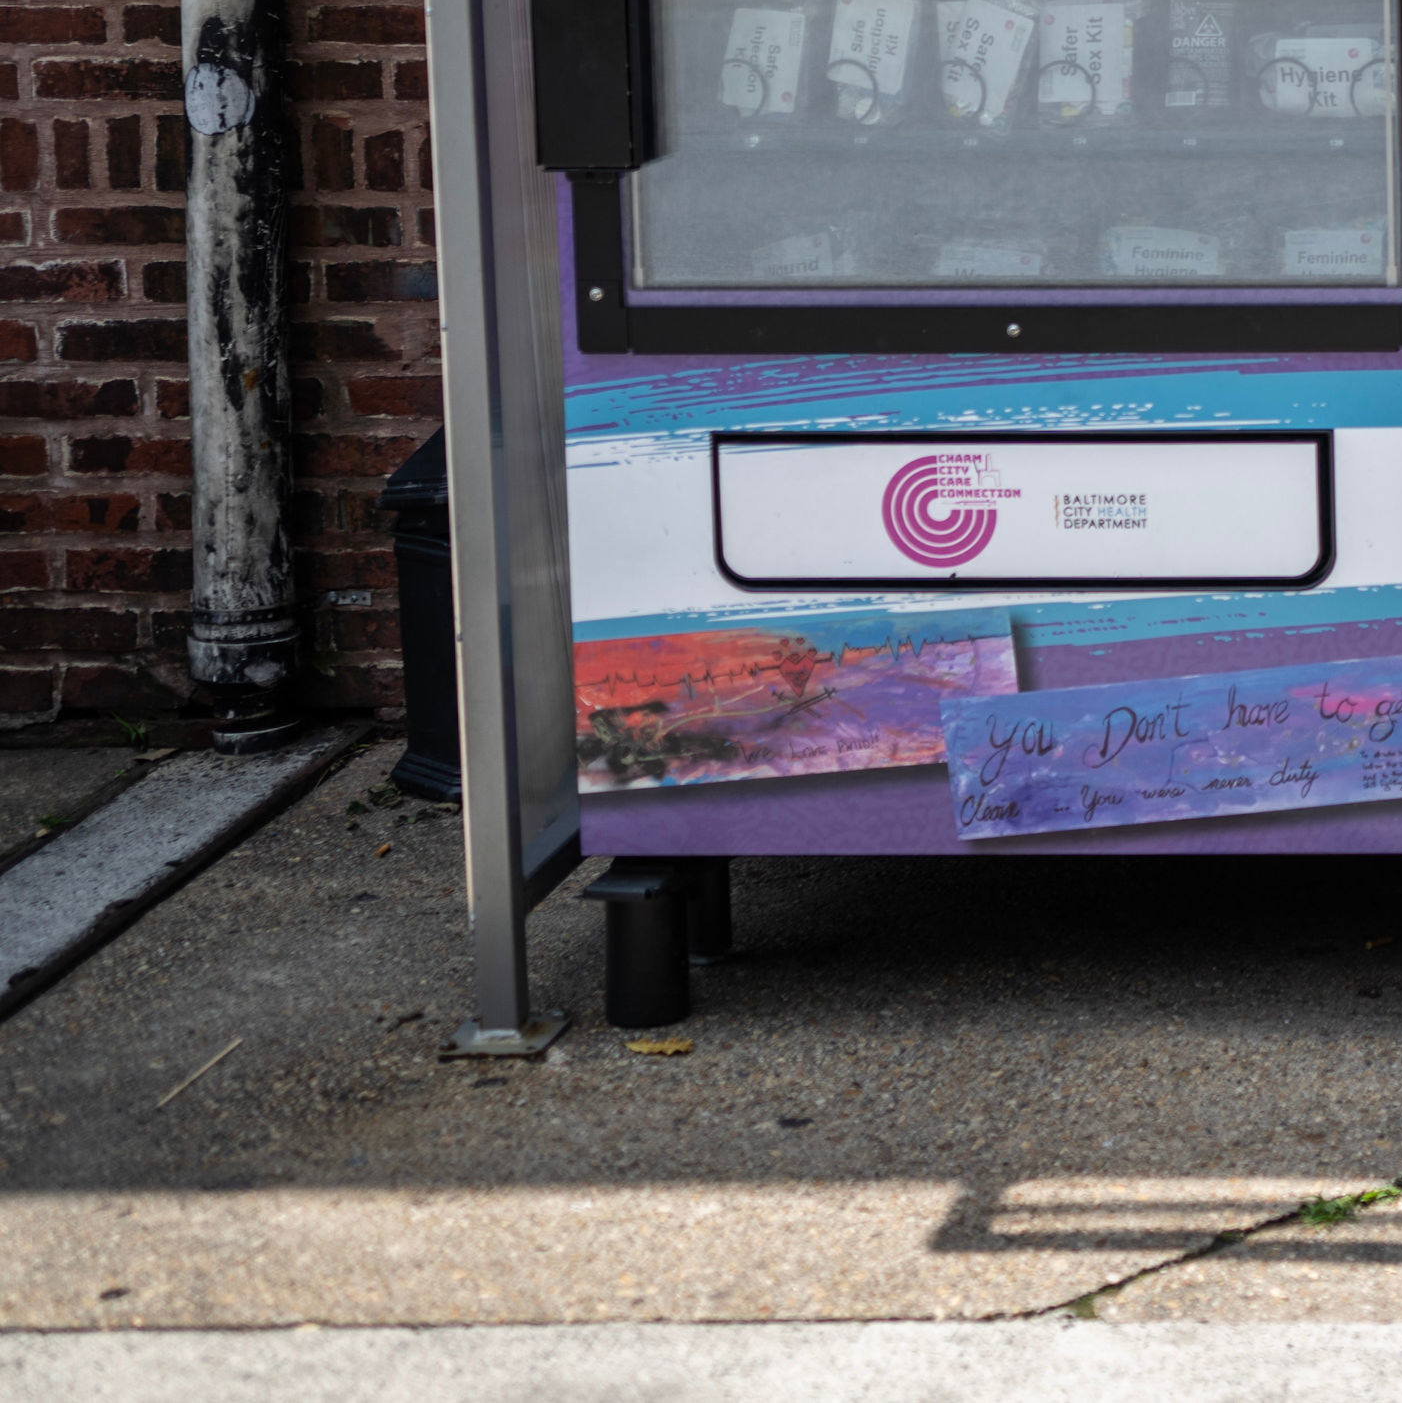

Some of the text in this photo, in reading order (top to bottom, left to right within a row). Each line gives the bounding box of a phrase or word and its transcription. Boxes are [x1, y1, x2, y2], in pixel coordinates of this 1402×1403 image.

[851, 19, 866, 53] Safe
[1086, 16, 1103, 43] Kit
[885, 34, 900, 56] Kit
[1172, 37, 1226, 48] DANGER
[1061, 26, 1079, 77] Safer
[765, 45, 781, 79] Safe
[1281, 67, 1363, 87] Hygiene
[1132, 246, 1204, 261] Feminine
[1297, 251, 1368, 265] Feminine
[937, 454, 982, 465] CHARM
[937, 465, 969, 475] CITY
[937, 477, 971, 487] CARE
[937, 488, 1021, 499] CONNECTION
[1063, 494, 1145, 506] BALTIMORE
[1062, 506, 1147, 518] CITY HEALTH
[1063, 518, 1147, 529] DEPARTMENT
[980, 713, 1056, 786] You
[1083, 702, 1190, 769] Don't
[1226, 684, 1290, 731] have
[1315, 679, 1355, 724] to
[960, 788, 1020, 827] Clean
[1140, 785, 1186, 801] were
[1206, 774, 1252, 792] never
[1269, 758, 1319, 798] dirty
